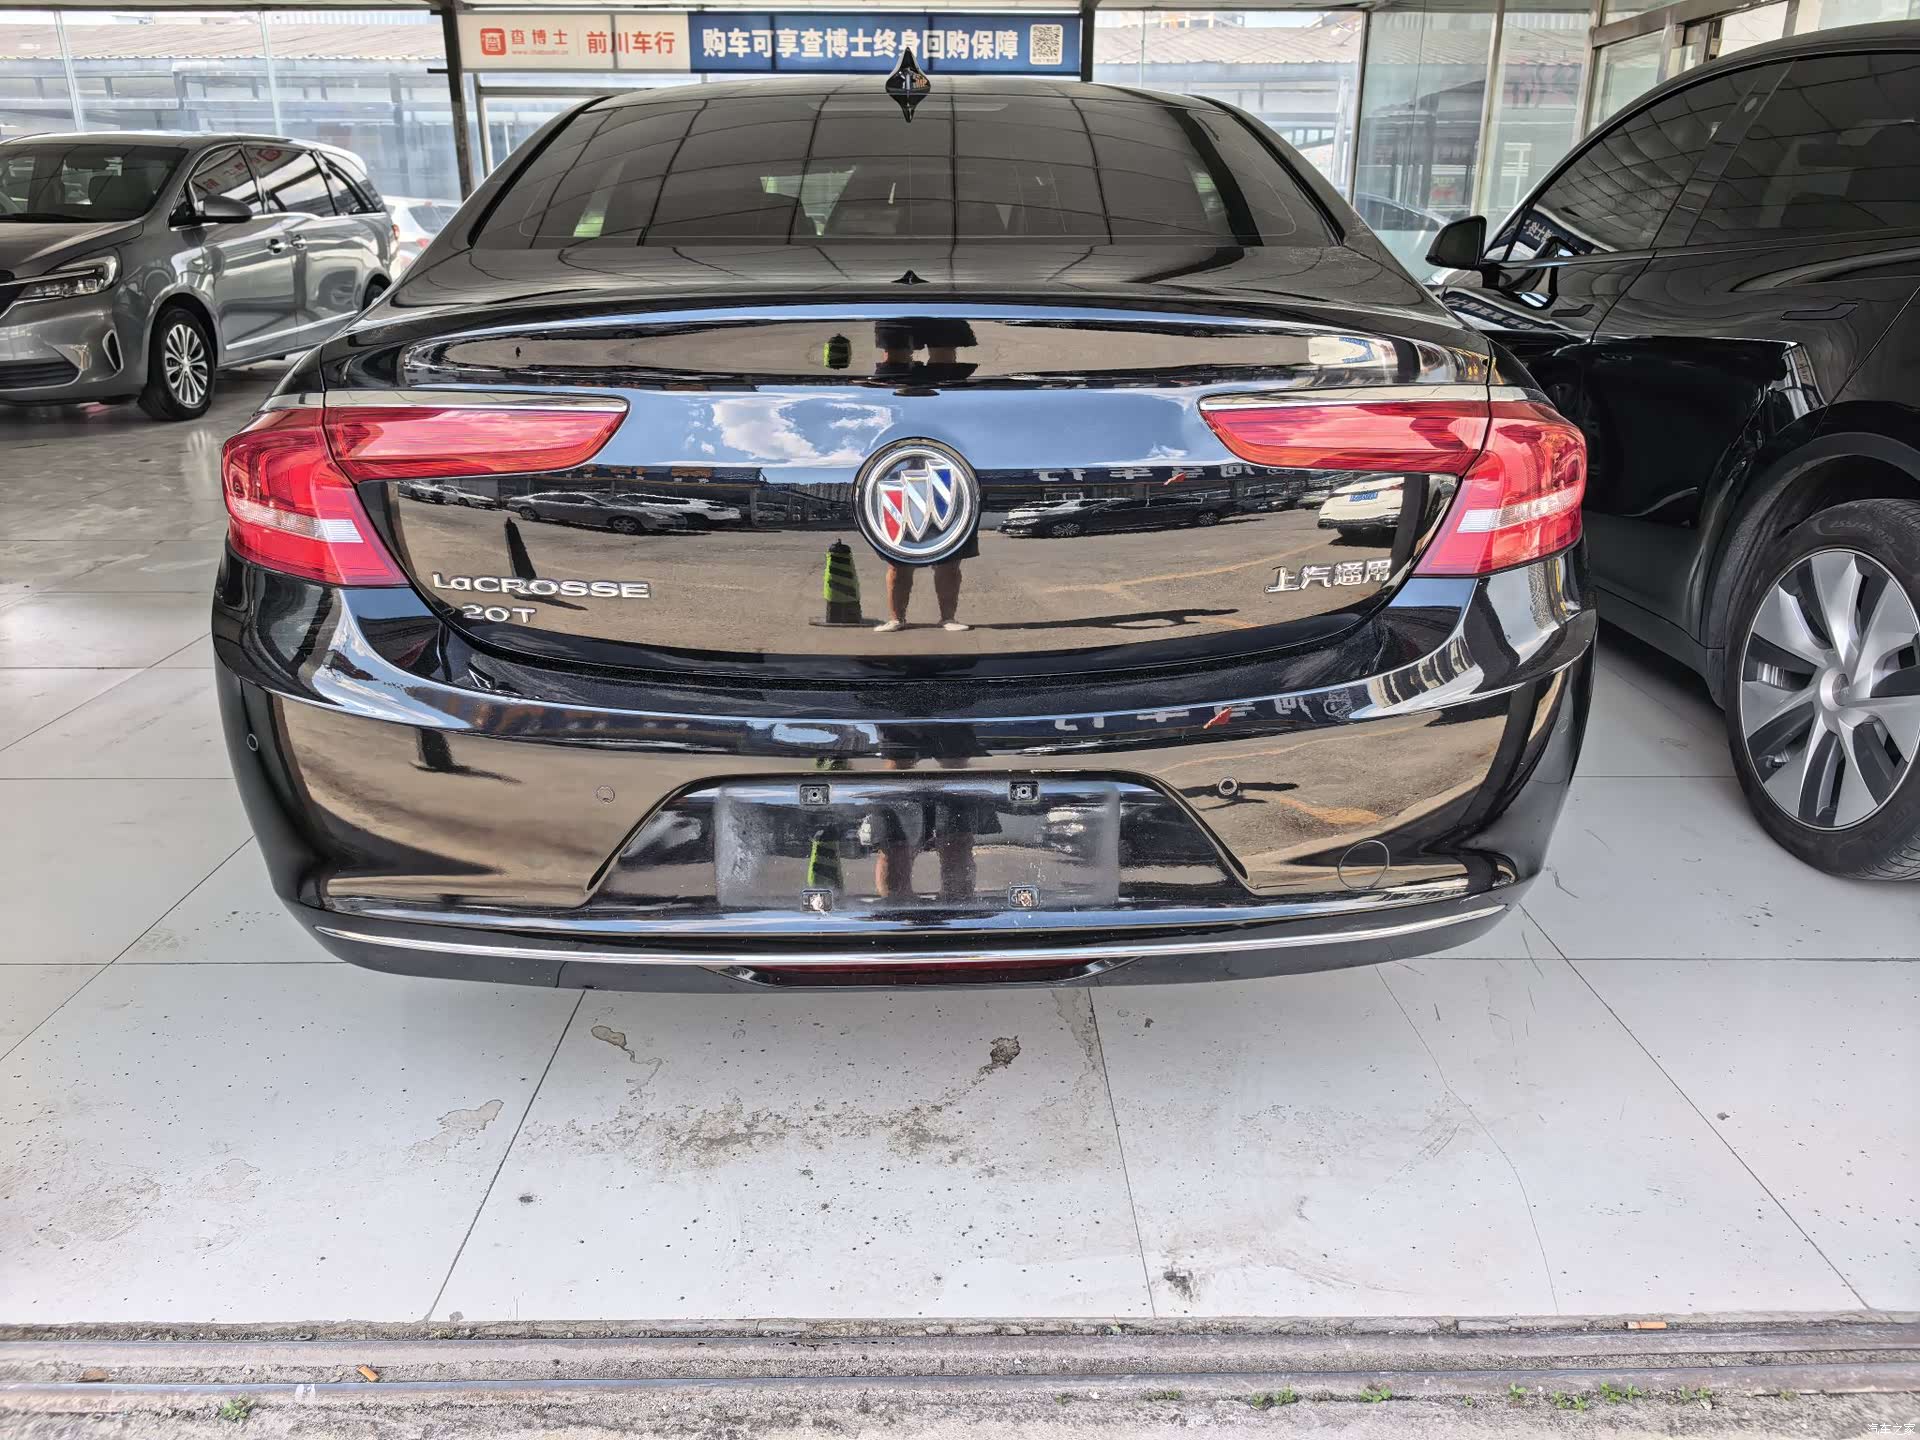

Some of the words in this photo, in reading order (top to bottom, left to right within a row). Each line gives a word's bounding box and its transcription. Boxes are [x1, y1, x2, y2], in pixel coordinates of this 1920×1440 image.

[510, 29, 568, 46] 查博士
[586, 31, 676, 54] 前川车行
[702, 28, 1019, 60] 购车可享查博士终身回购保障
[1264, 558, 1392, 594] 上汽通用
[461, 604, 536, 624] 20T
